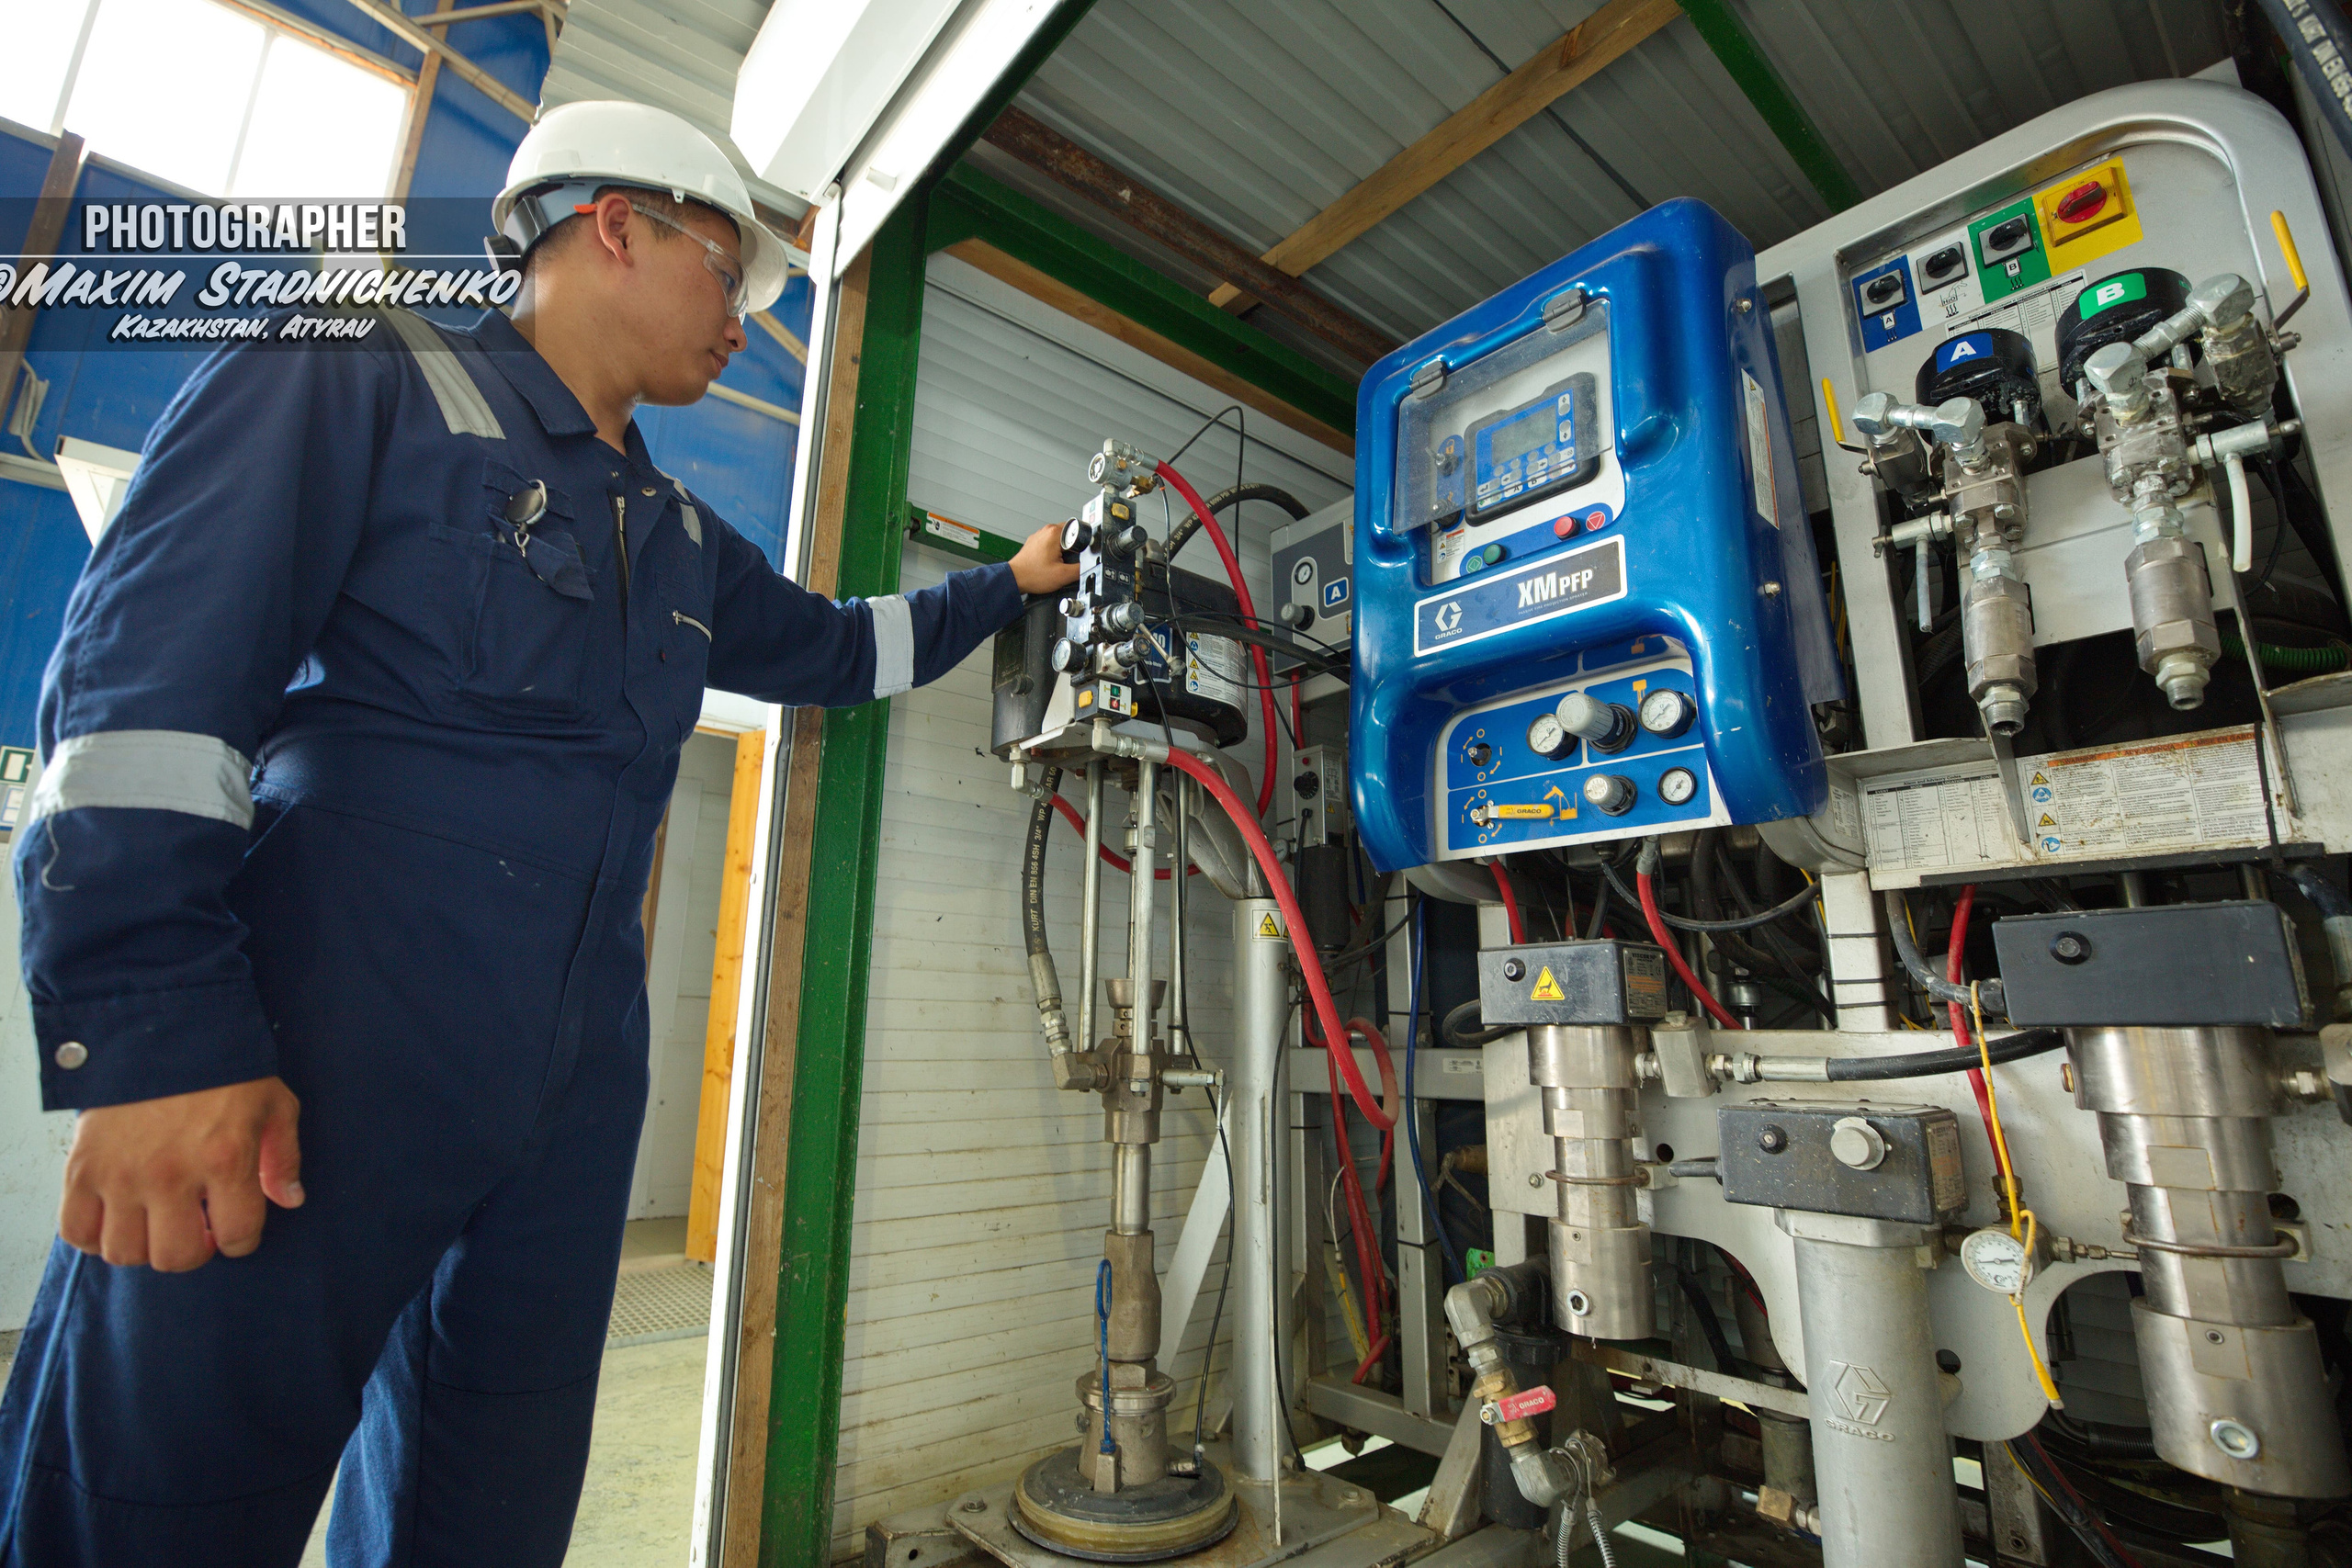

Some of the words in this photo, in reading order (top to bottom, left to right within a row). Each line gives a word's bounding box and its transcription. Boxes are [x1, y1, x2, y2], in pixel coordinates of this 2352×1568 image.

[2008, 263, 2017, 271] B
[2096, 282, 2125, 307] B
[1950, 340, 1977, 363] A
[1330, 585, 1341, 601] A
[1434, 627, 1463, 640] GRACO
[1036, 807, 1046, 821] WP
[1031, 843, 1041, 860] 4SH
[1030, 861, 1039, 875] 856
[1029, 876, 1037, 888] EN
[1029, 889, 1038, 904] DIN
[1030, 908, 1040, 931] KURT
[1518, 1395, 1545, 1410] GRACO
[1823, 1416, 1896, 1443] GRACO
